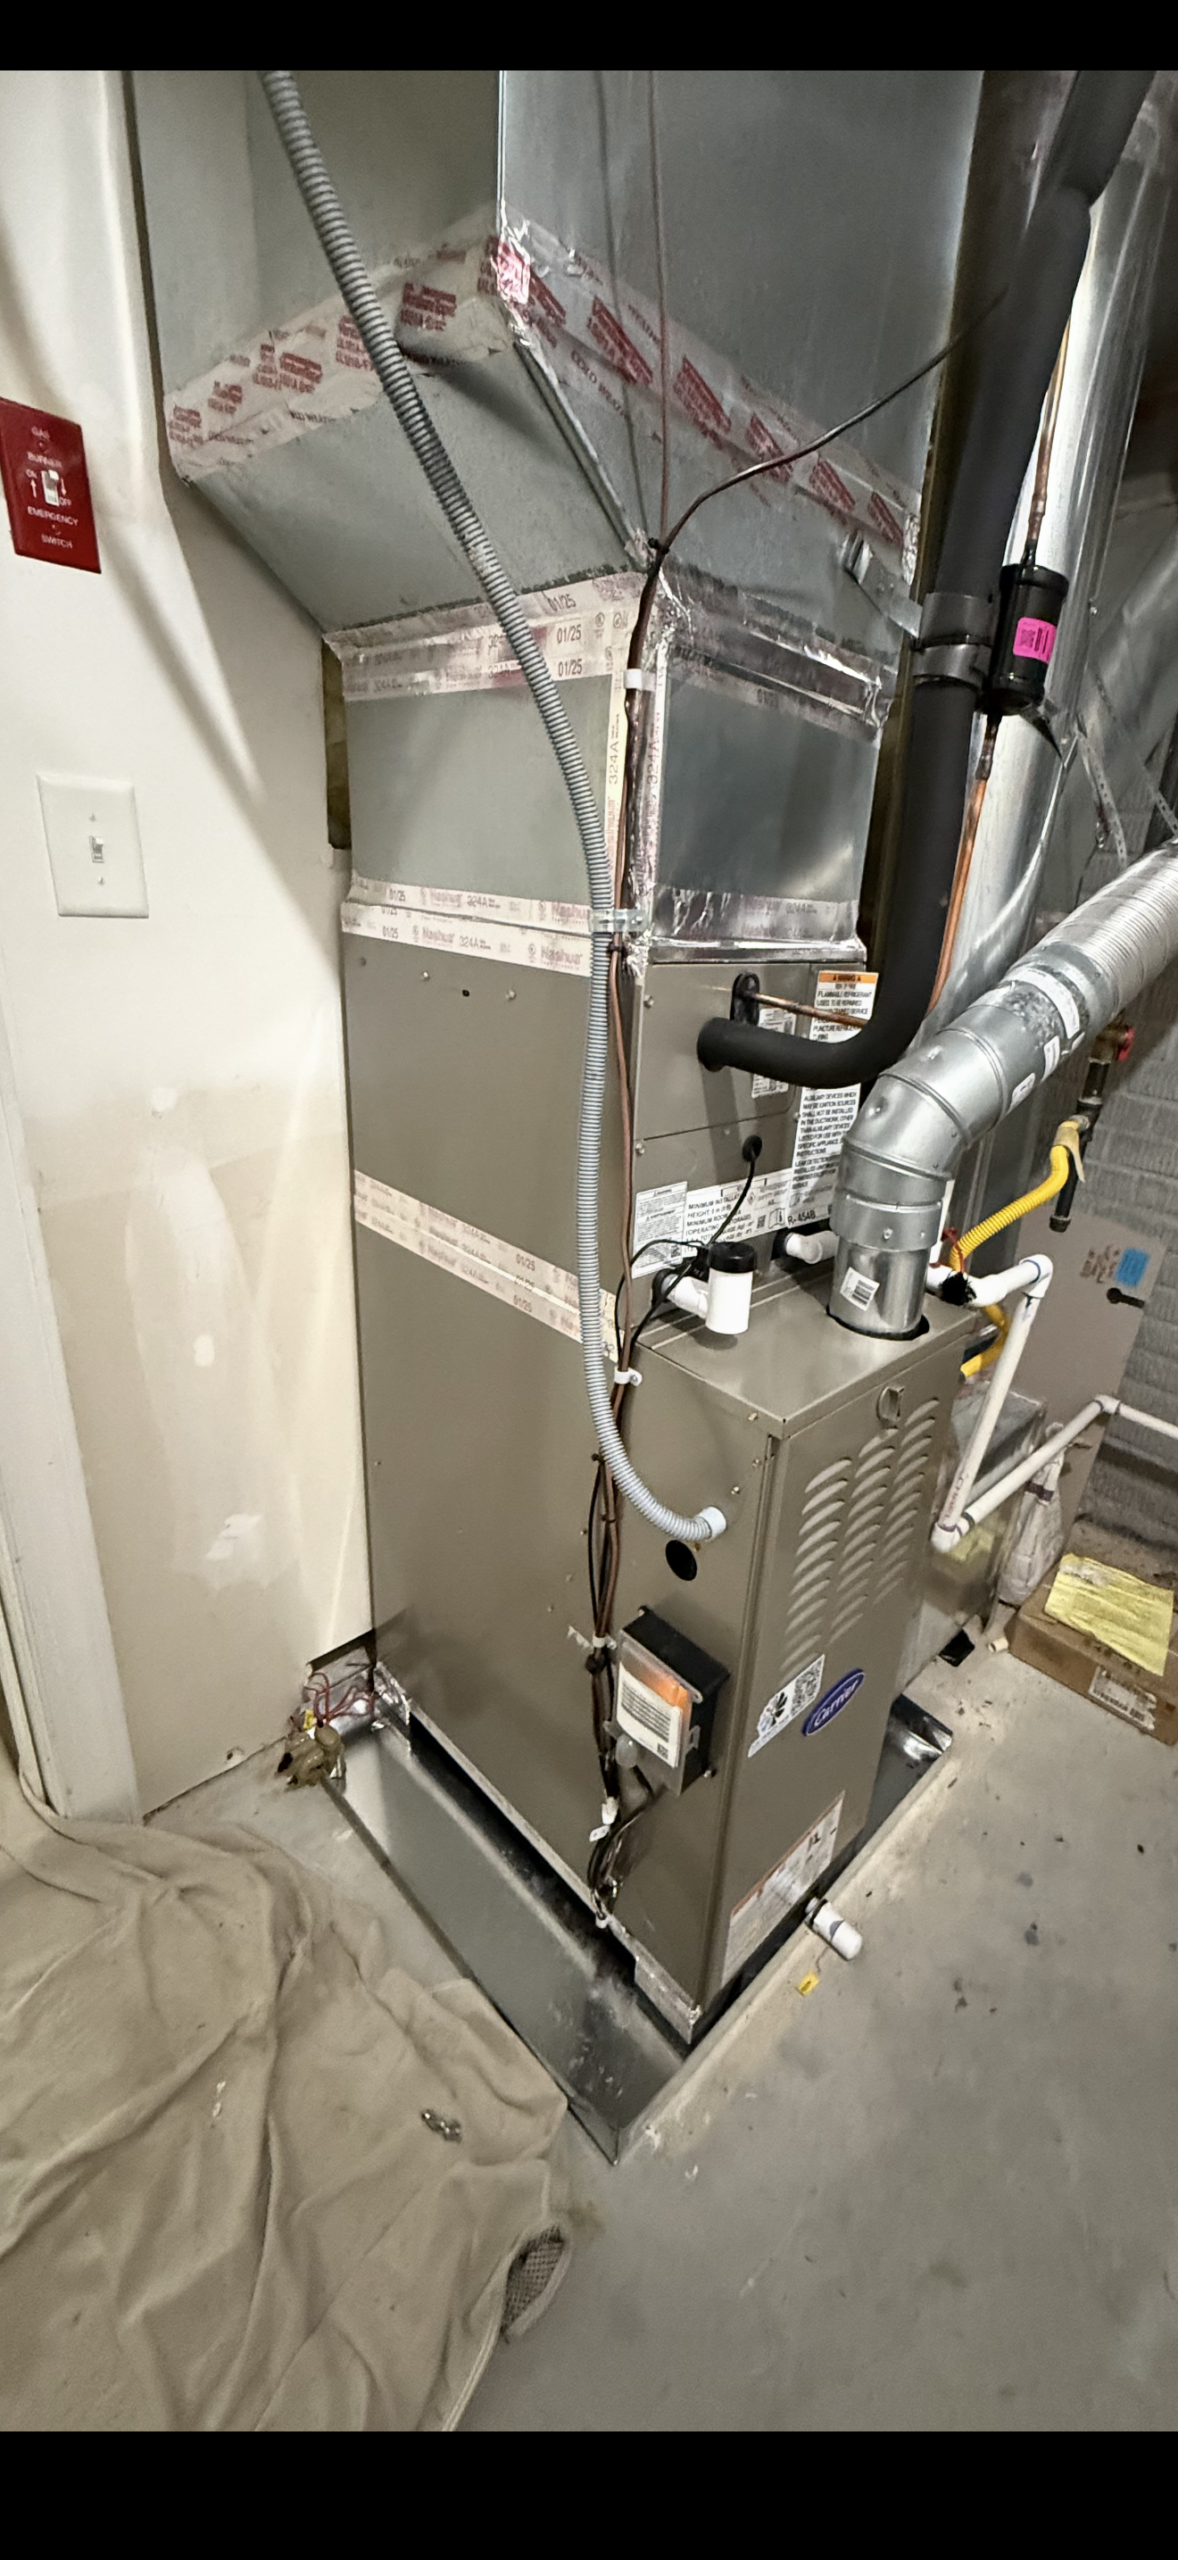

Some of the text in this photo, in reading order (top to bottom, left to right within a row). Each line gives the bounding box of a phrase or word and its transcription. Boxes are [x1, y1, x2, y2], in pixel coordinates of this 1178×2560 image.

[31, 426, 50, 439] GAS
[27, 452, 62, 468] BURNER
[59, 497, 72, 507] OFF
[27, 506, 78, 526] EMERGENCY
[41, 533, 73, 549] SWITCH
[548, 594, 576, 612] 01/25
[557, 625, 582, 643] 01/25
[558, 659, 582, 677] 01/25
[608, 741, 619, 785] 324A
[647, 741, 660, 785] 324A
[389, 888, 406, 902] 01/25
[382, 925, 399, 940] 01/25
[422, 926, 455, 944] Nashua
[459, 935, 481, 948] 324A
[541, 945, 582, 965] Nashua
[825, 1092, 843, 1100] DEVICES
[688, 1201, 714, 1209] MINIMUM
[687, 1217, 713, 1226] MINIMUM
[515, 1253, 535, 1271] 01/25
[514, 1275, 534, 1292] 01/25
[513, 1294, 533, 1313] 01/25
[813, 1679, 859, 1727] Carrier
